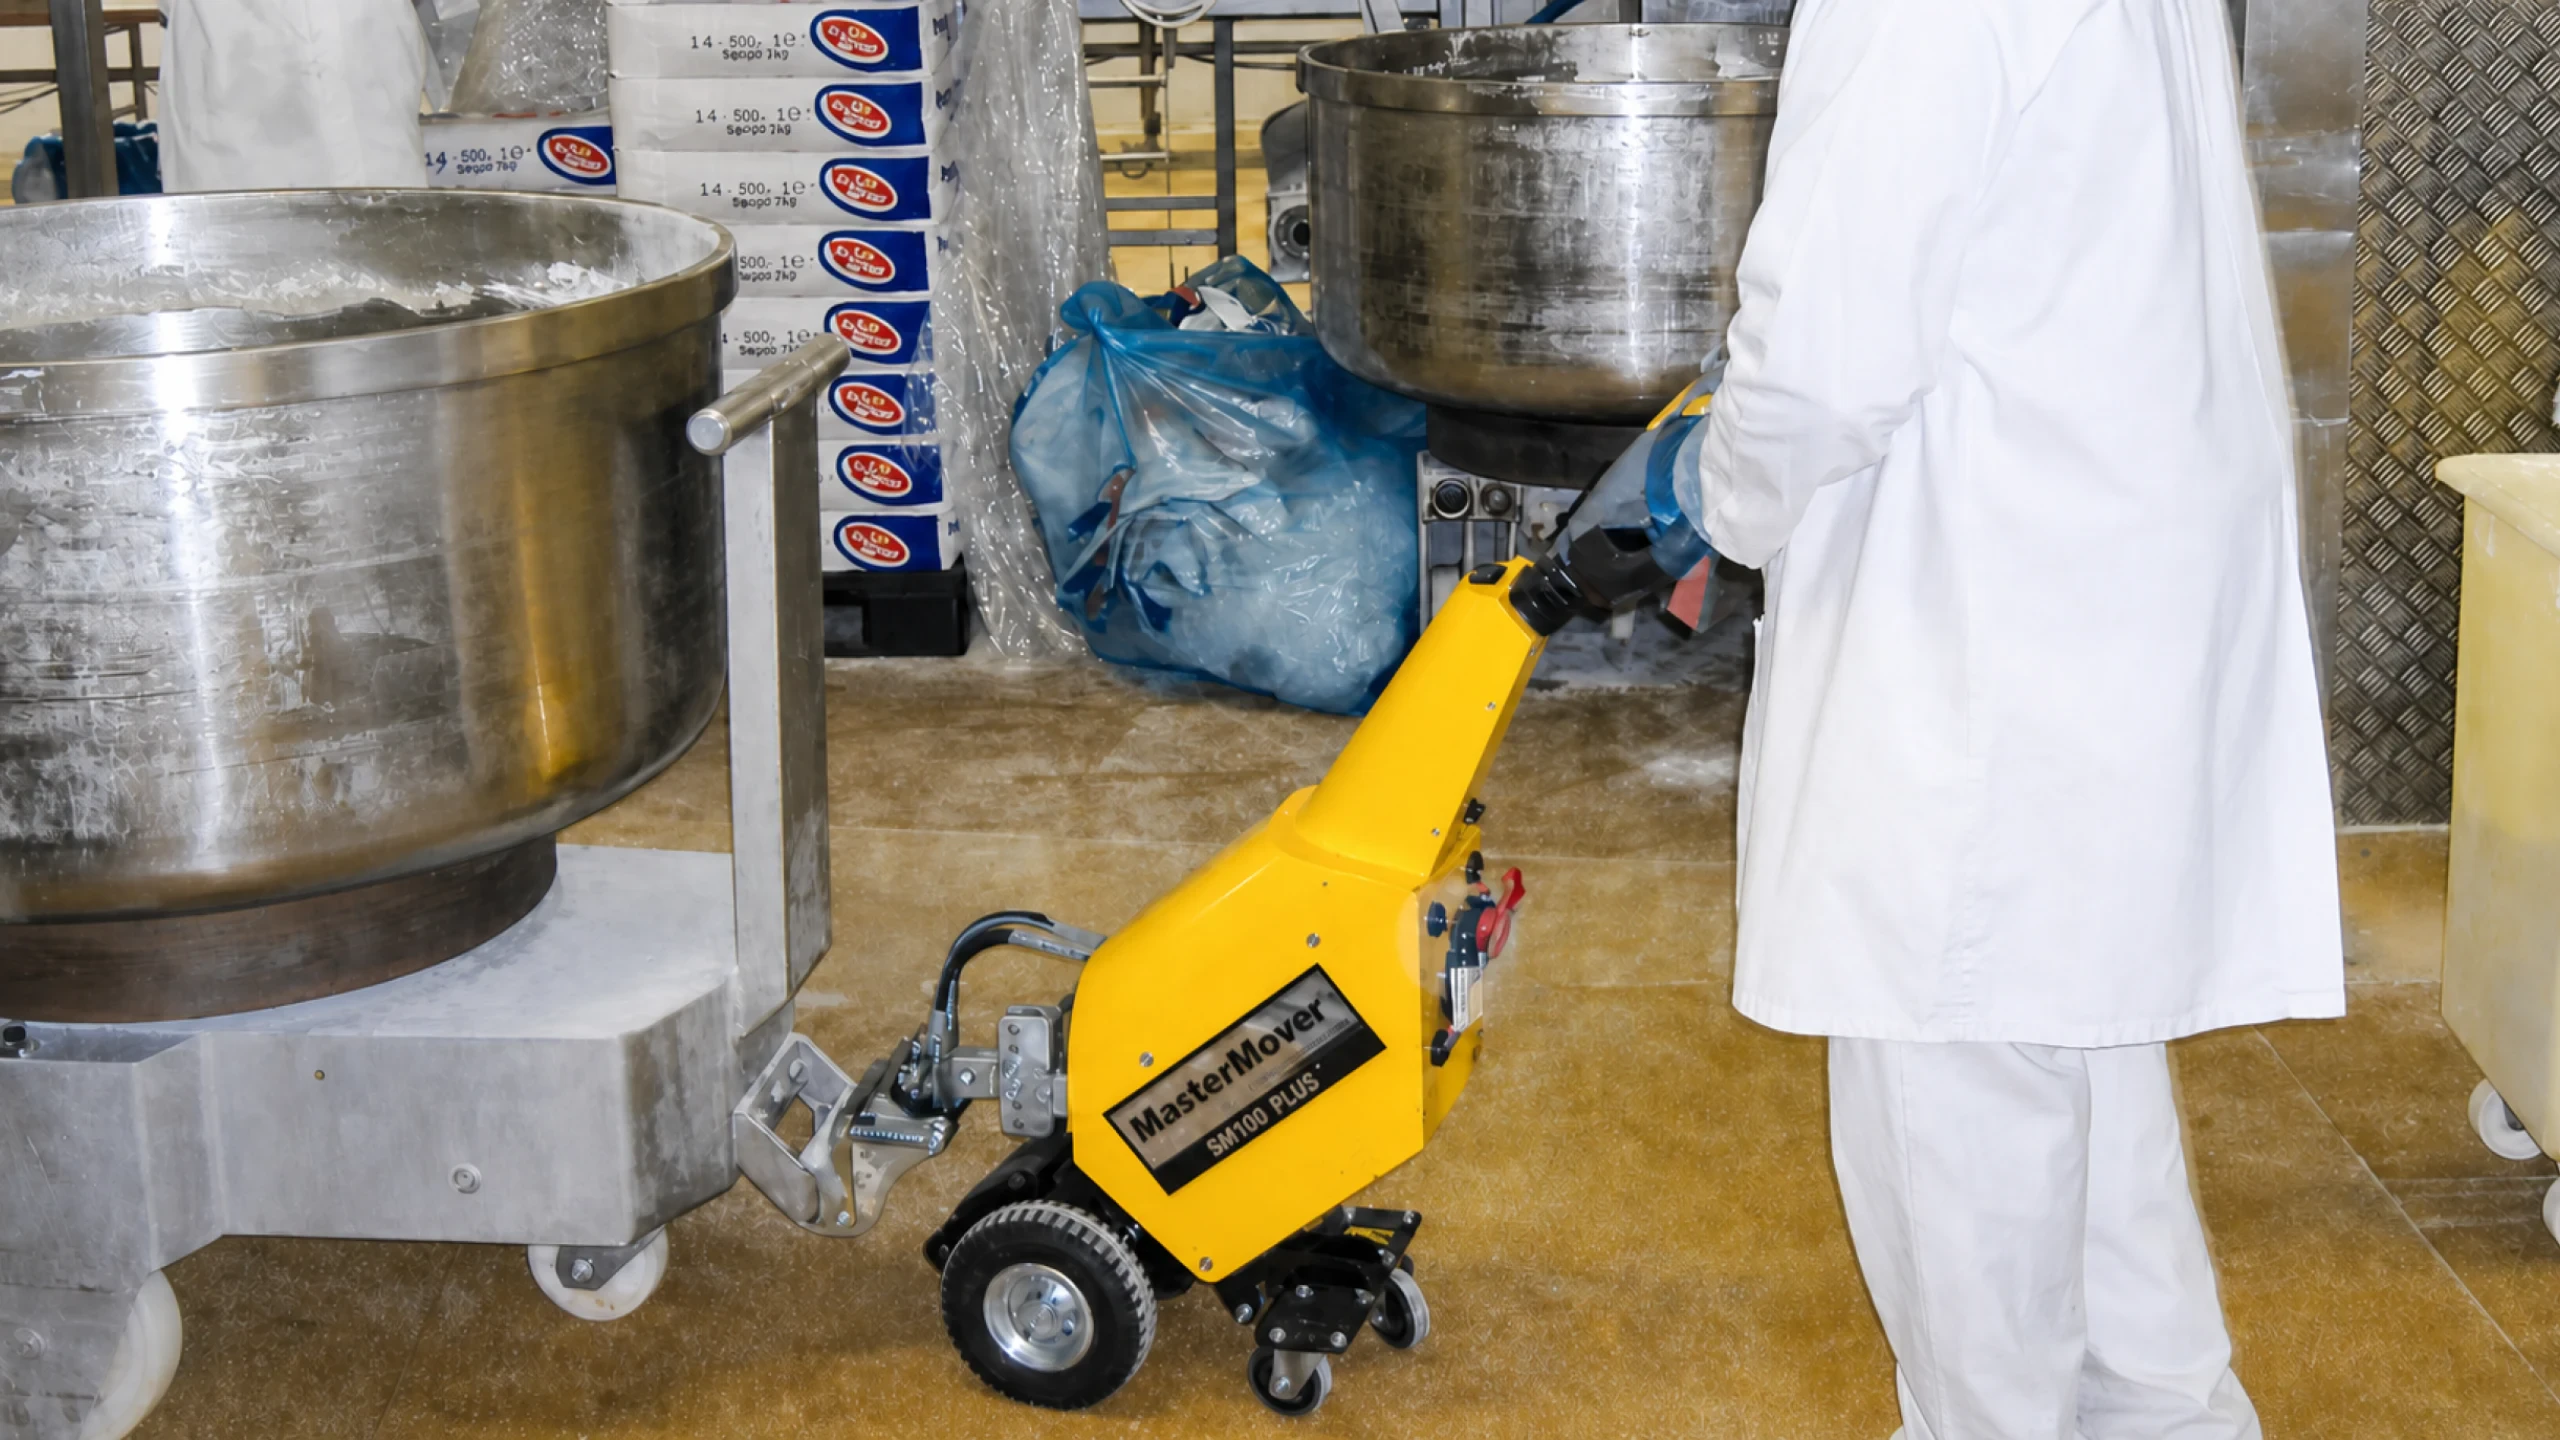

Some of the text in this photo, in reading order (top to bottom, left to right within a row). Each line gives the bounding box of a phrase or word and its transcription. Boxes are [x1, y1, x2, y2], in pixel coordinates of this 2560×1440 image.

[1129, 996, 1326, 1144] MasterMover
[1206, 1071, 1321, 1158] SM100 PLUS
